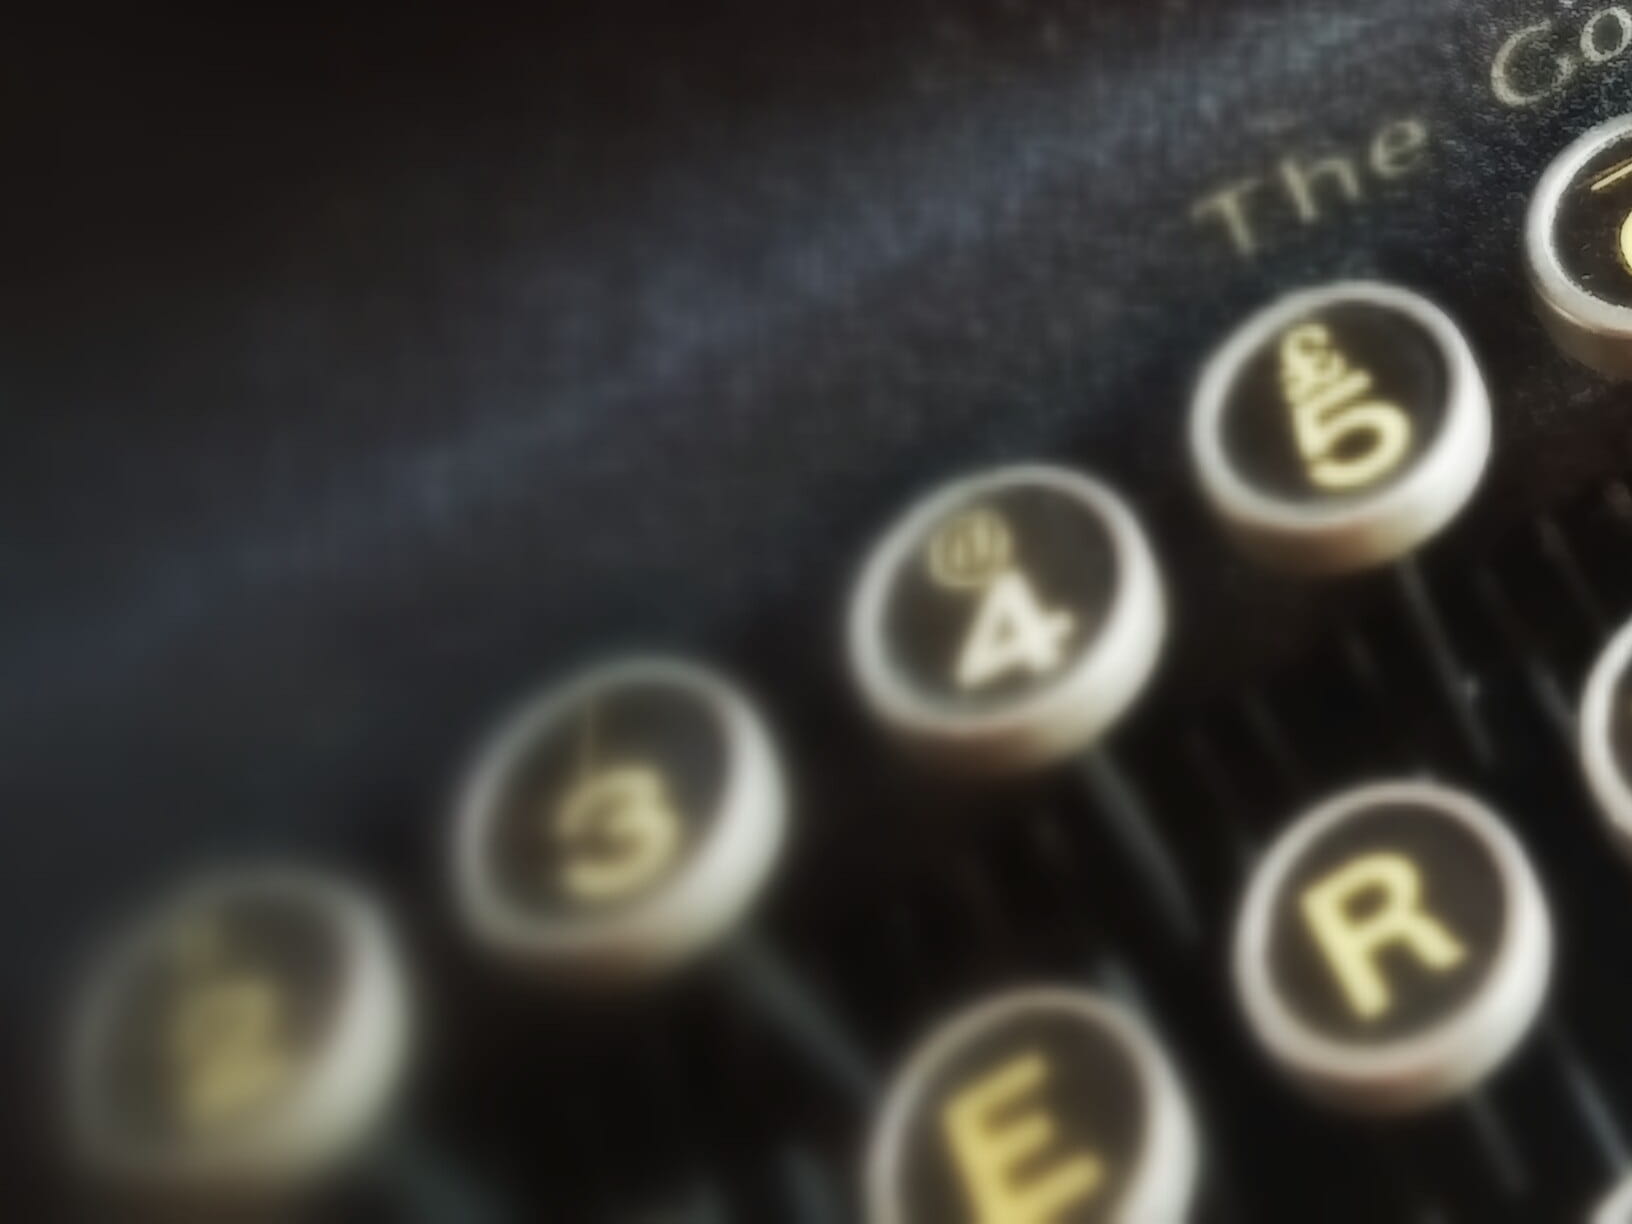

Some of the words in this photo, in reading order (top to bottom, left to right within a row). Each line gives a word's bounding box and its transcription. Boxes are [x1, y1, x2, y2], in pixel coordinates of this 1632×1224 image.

[1200, 118, 1428, 253] The
[1294, 370, 1409, 487] 5
[957, 571, 1072, 688] 4
[558, 764, 680, 896] 3
[1301, 854, 1464, 1020] R
[943, 1054, 1103, 1224] E
